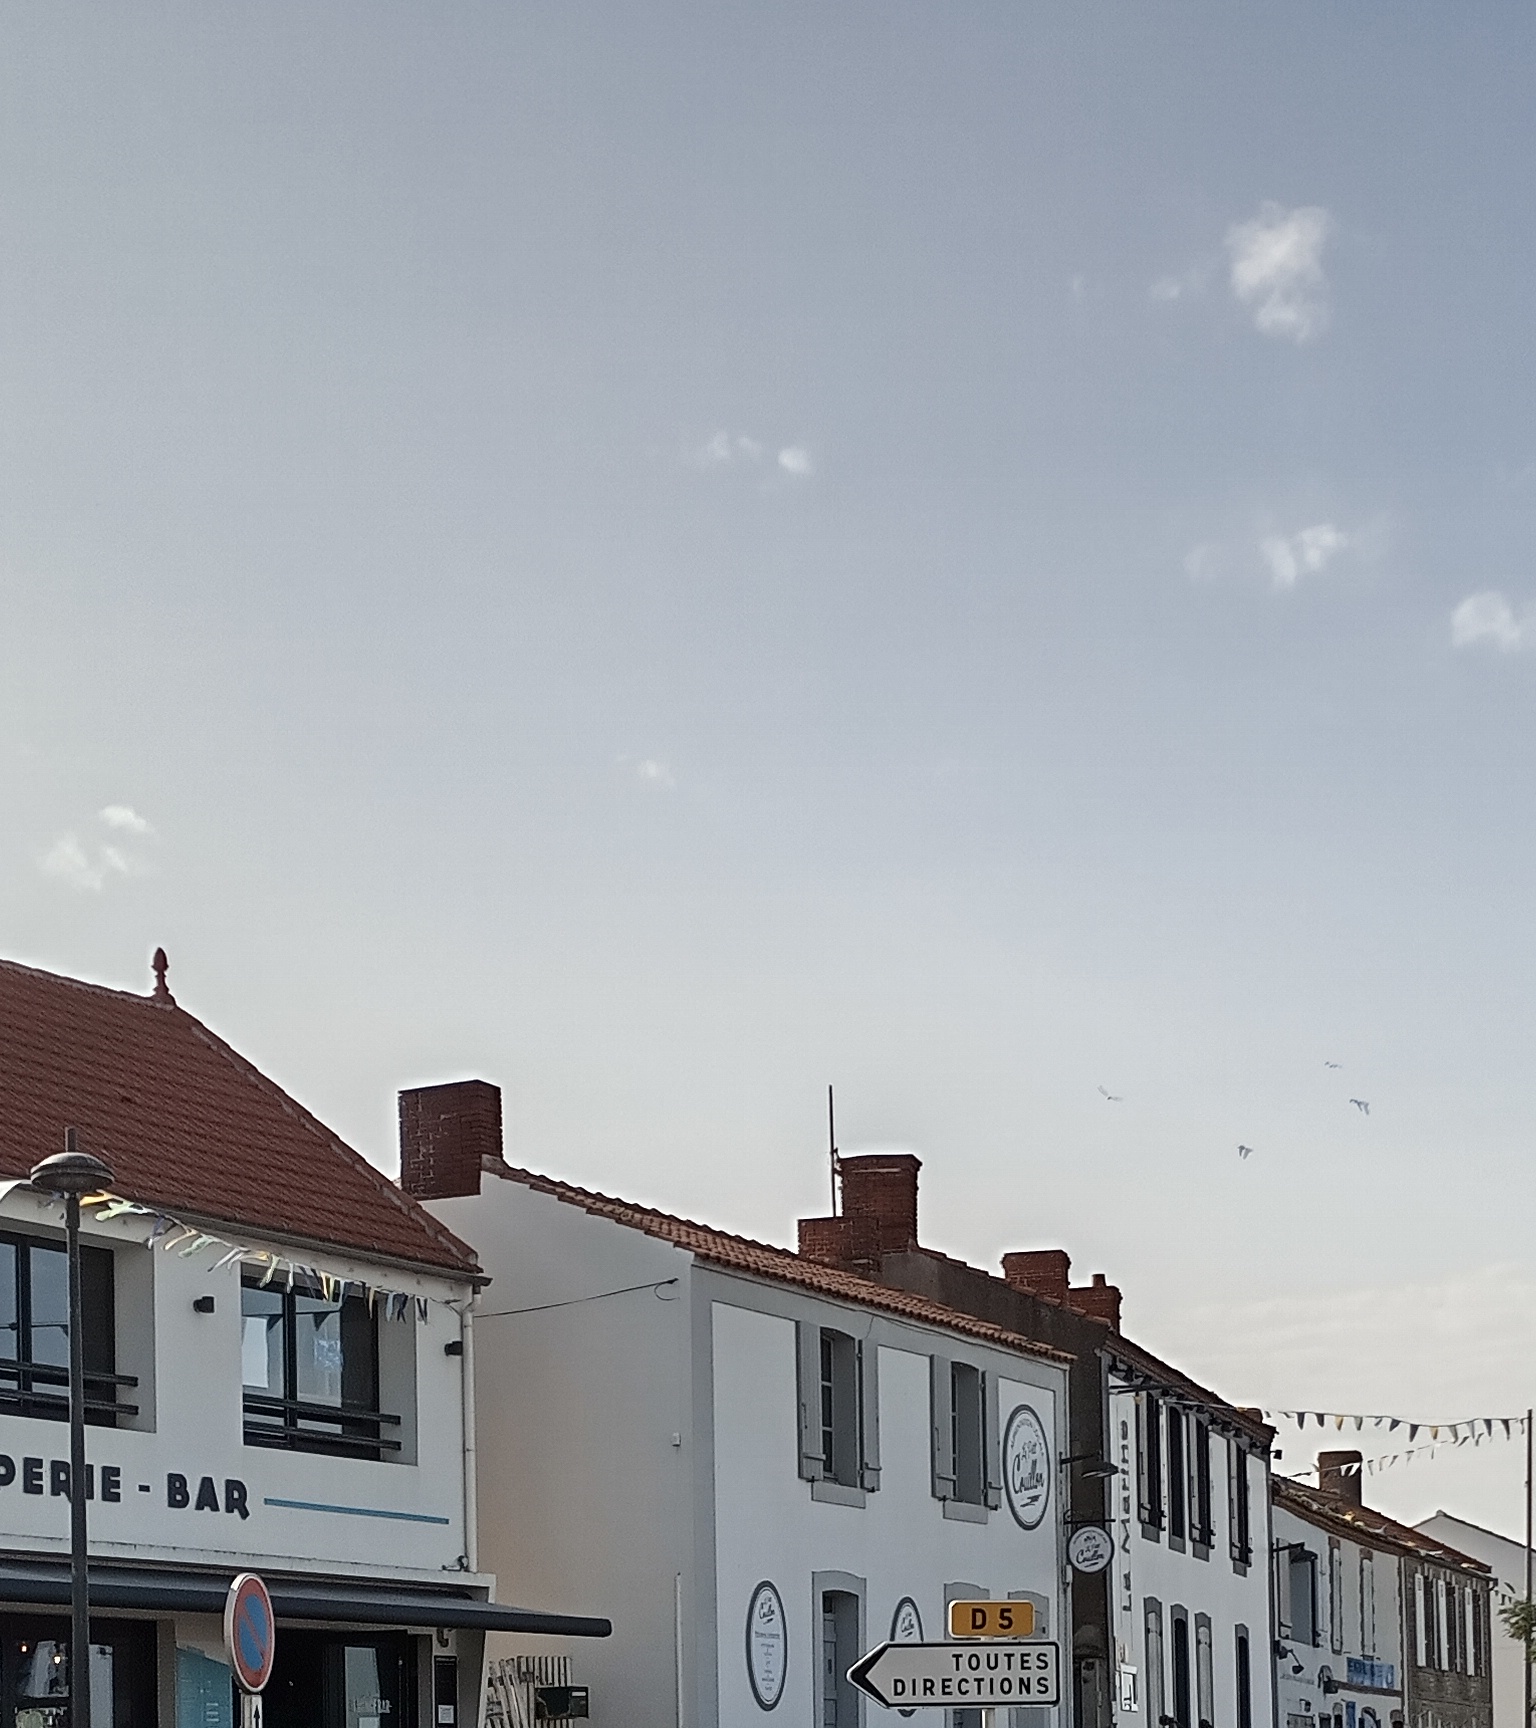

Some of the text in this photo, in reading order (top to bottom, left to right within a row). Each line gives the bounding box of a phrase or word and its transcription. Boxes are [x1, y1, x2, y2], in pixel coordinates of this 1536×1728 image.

[166, 1472, 252, 1521] BAR
[970, 1608, 1013, 1631] D 5
[952, 1652, 1049, 1672] TOUTES
[893, 1677, 1049, 1697] DIRECTIONS
